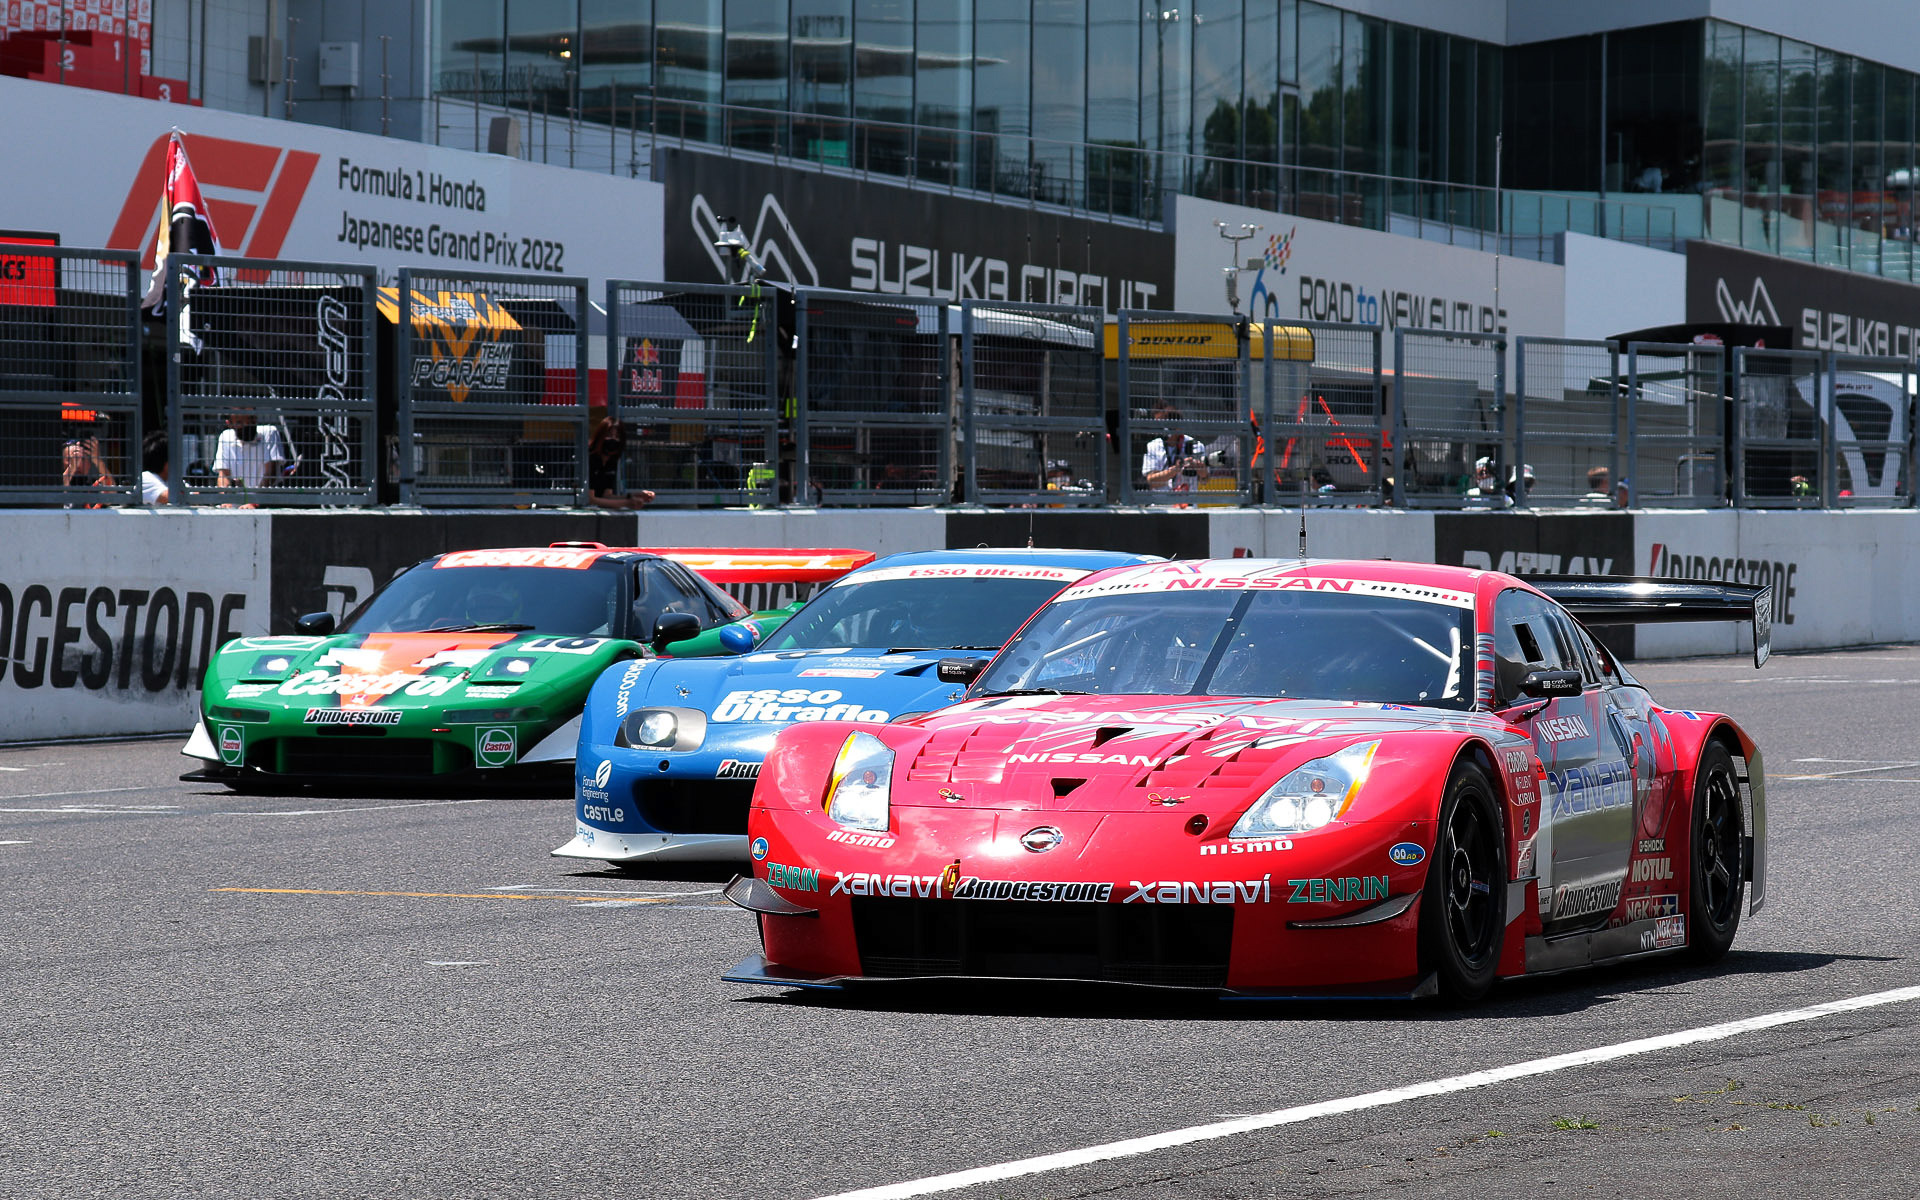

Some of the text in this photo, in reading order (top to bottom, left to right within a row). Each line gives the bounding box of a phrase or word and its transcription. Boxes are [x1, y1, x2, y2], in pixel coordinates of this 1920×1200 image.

[63, 50, 75, 71] 2
[114, 40, 121, 61] 1
[158, 84, 172, 102] 3
[338, 158, 486, 212] Formula 1 Honda
[337, 210, 564, 273] Japanese Grand Prix 2022
[850, 236, 1009, 302] SUZUKA
[1300, 275, 1354, 322] ROAD
[1356, 285, 1378, 325] to
[1137, 335, 1212, 345] DUNLOP
[1802, 308, 1890, 357] SUZUKA
[480, 343, 513, 360] TEAM
[441, 551, 595, 568] Castrol
[909, 568, 1064, 578] ESSO Ultraflo
[1165, 577, 1354, 592] NISSAN
[277, 670, 463, 697] Castrol
[725, 689, 843, 705] ESSO
[303, 708, 403, 725] BRIDGESTONE
[711, 702, 890, 723] Ultraflo
[1536, 715, 1590, 744] NISSAN
[484, 741, 514, 752] Castrol
[1008, 753, 1161, 768] NISSAN
[583, 786, 609, 803] Engineering
[826, 829, 896, 849] nismo
[1200, 838, 1293, 856] nismo
[1638, 838, 1665, 852] G-SHOCK
[766, 861, 821, 893] ZENRIN
[1631, 857, 1674, 883] MOTUL
[953, 876, 1116, 903] BRIDGESTONE
[1287, 875, 1389, 903] ZENRIN
[1553, 879, 1622, 920] BRIDGESTONE
[1626, 899, 1651, 923] NGK
[1640, 928, 1656, 950] NTN
[1656, 918, 1671, 940] NGK
